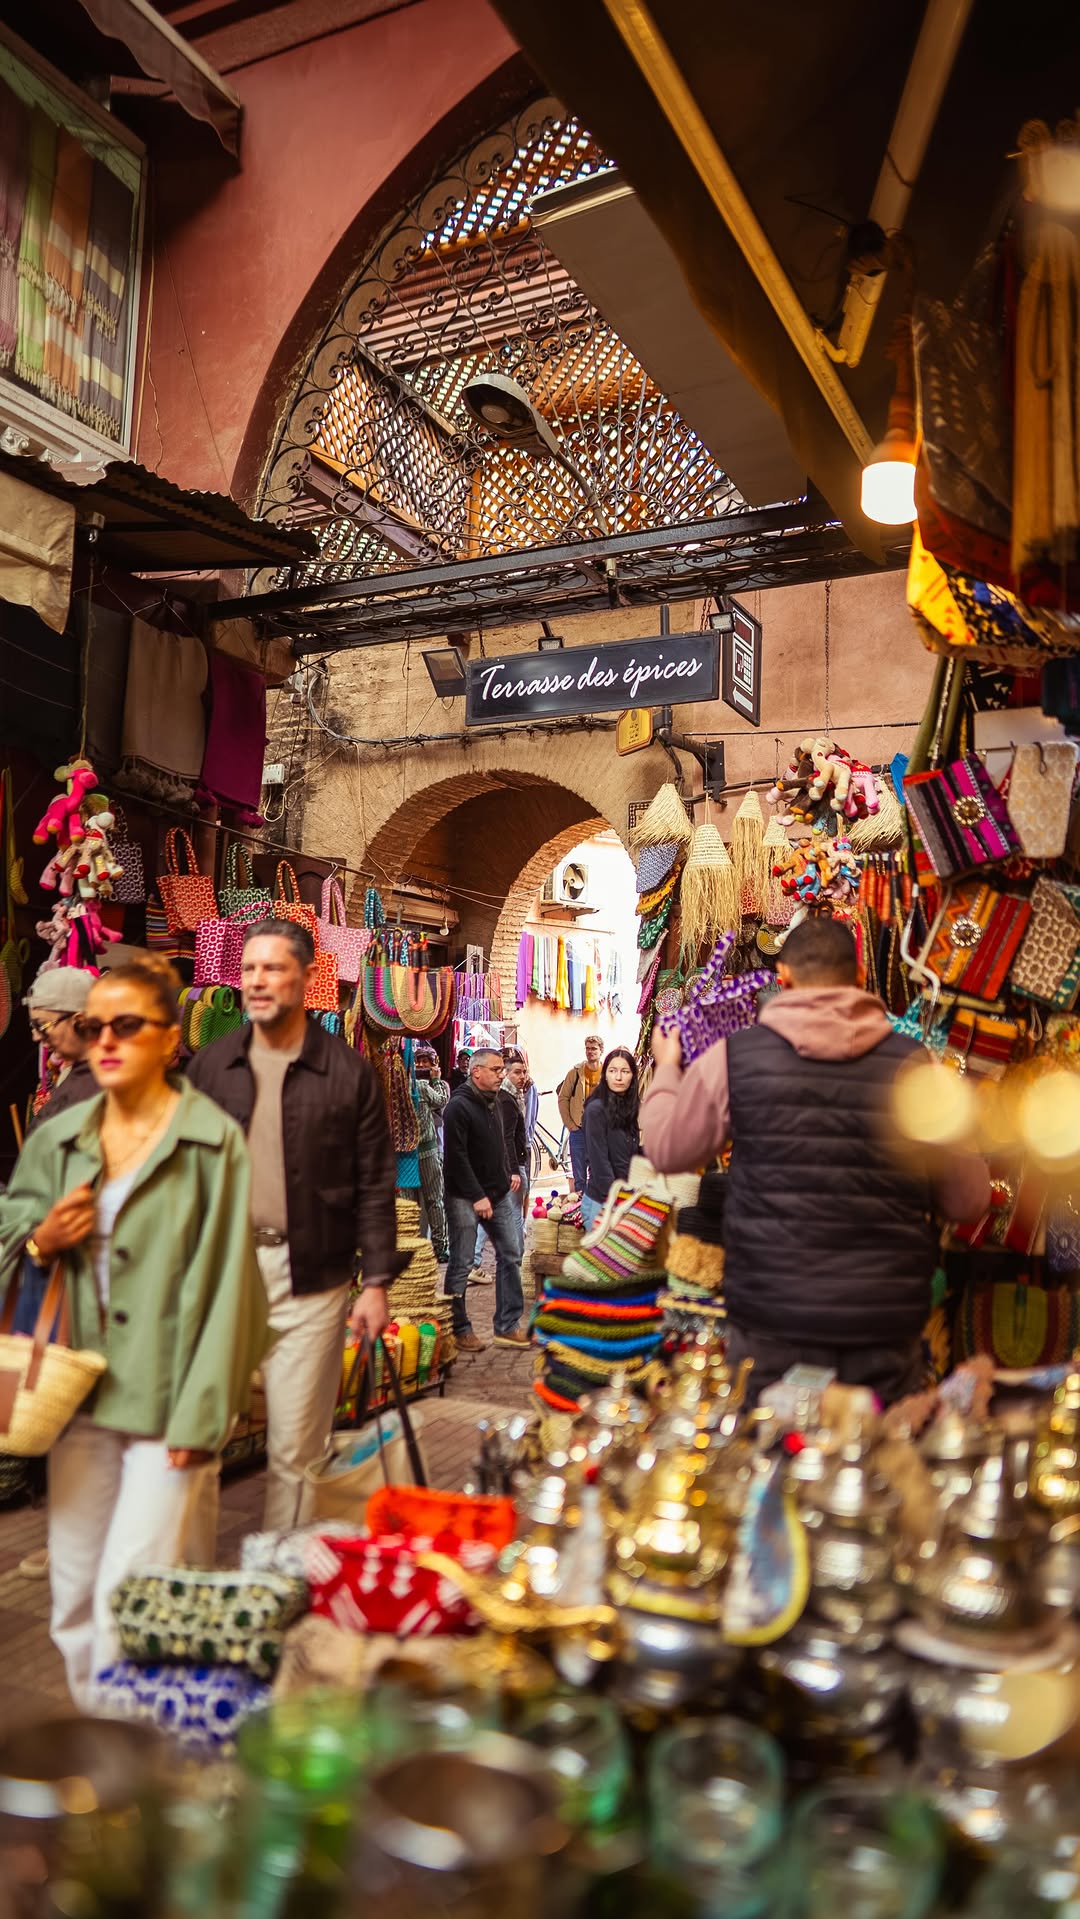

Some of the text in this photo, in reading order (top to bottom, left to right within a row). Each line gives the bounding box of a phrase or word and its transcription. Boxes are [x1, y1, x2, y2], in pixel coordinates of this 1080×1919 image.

[480, 654, 702, 700] Terrasse des épices
